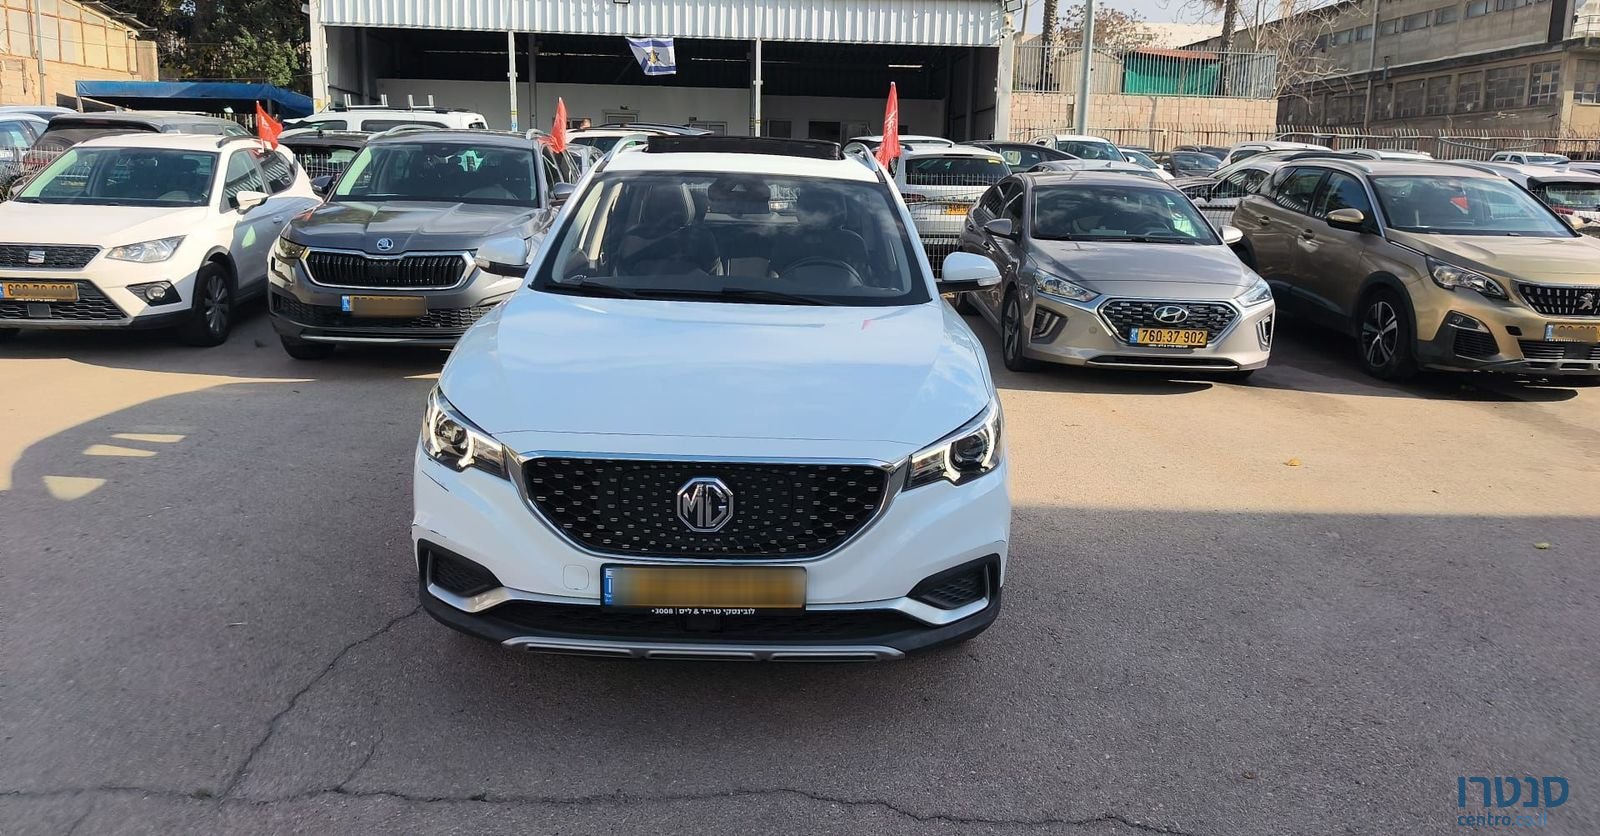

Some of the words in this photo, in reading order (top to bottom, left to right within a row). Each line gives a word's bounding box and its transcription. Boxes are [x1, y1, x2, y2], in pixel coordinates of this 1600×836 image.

[682, 484, 728, 528] MG
[679, 607, 692, 615] ליס
[723, 608, 755, 616] לובינסקי
